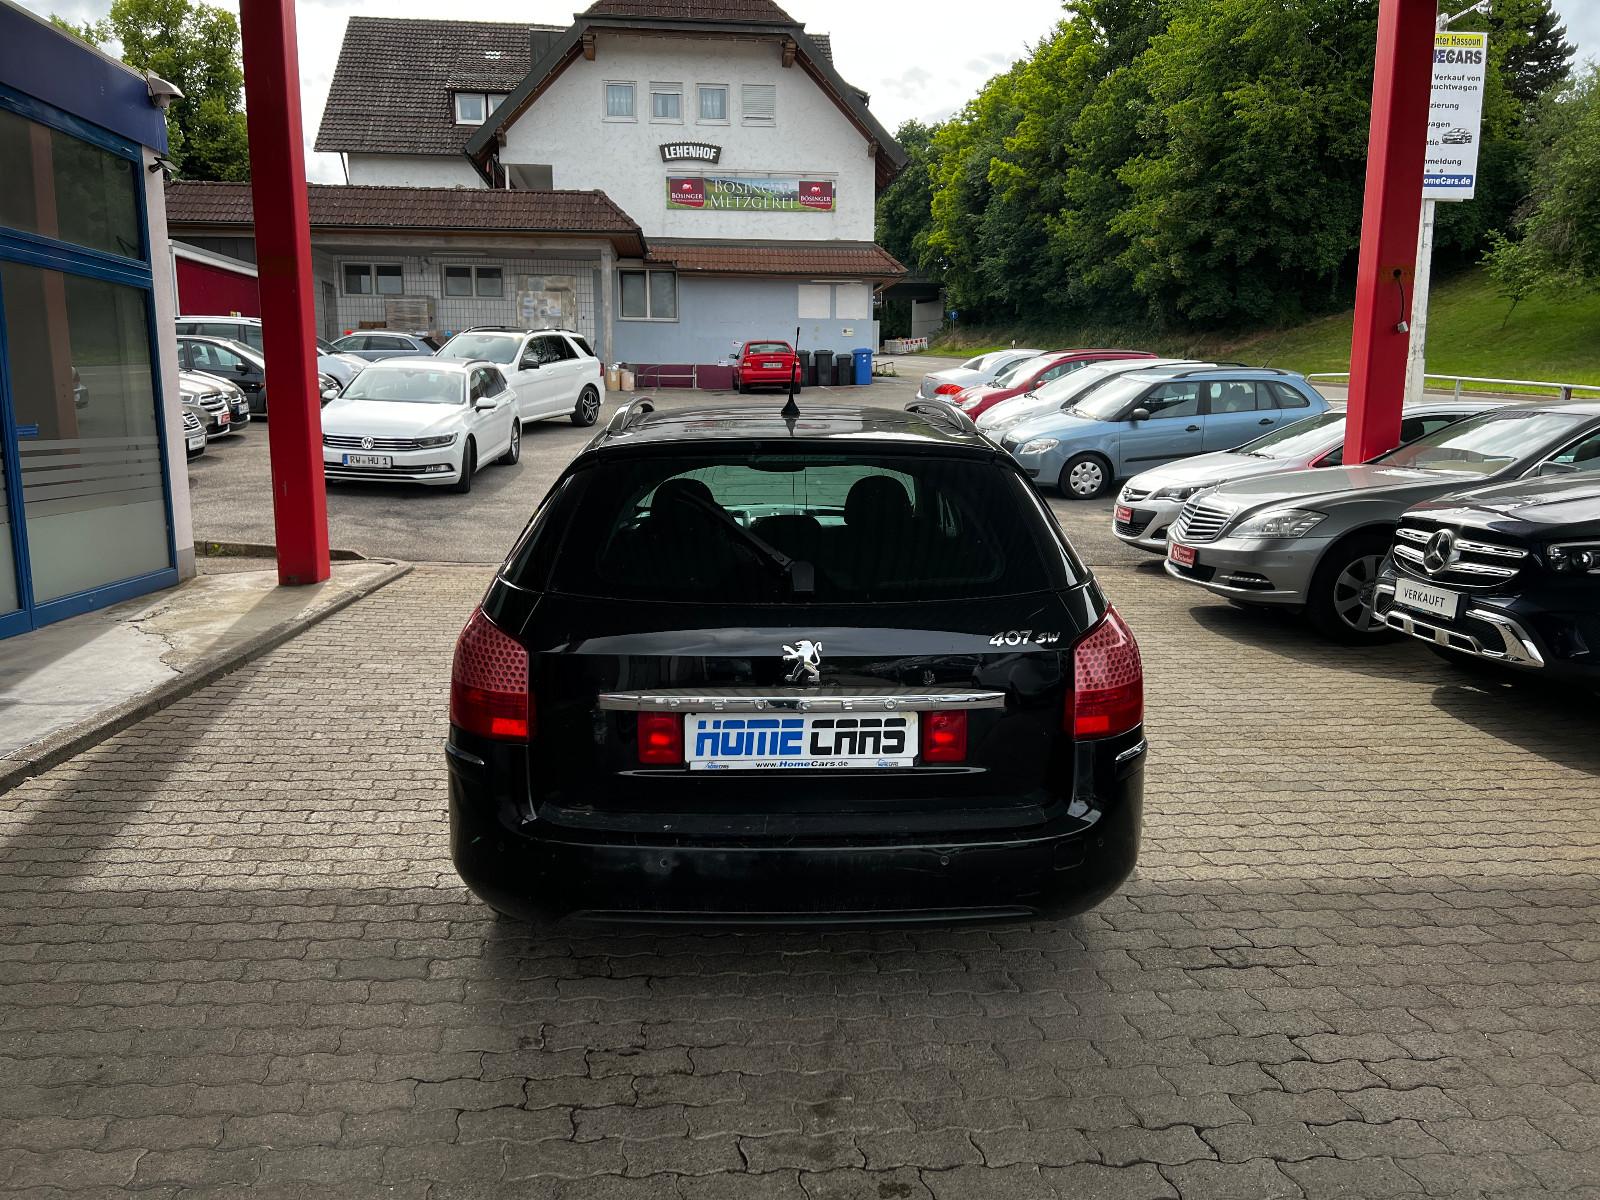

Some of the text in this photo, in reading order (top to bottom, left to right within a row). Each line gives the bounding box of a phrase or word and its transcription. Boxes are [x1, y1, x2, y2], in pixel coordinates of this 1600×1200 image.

[1451, 35, 1481, 46] Hassoun
[1434, 73, 1465, 81] Verkauf
[664, 145, 717, 160] LEHENHOF
[710, 194, 793, 209] METZGEREI
[350, 455, 361, 464] RW
[1404, 587, 1446, 608] VERKAUFT
[989, 629, 1033, 647] 407
[695, 717, 907, 757] HOME CARS
[755, 759, 849, 769] www.HomeCars.de
